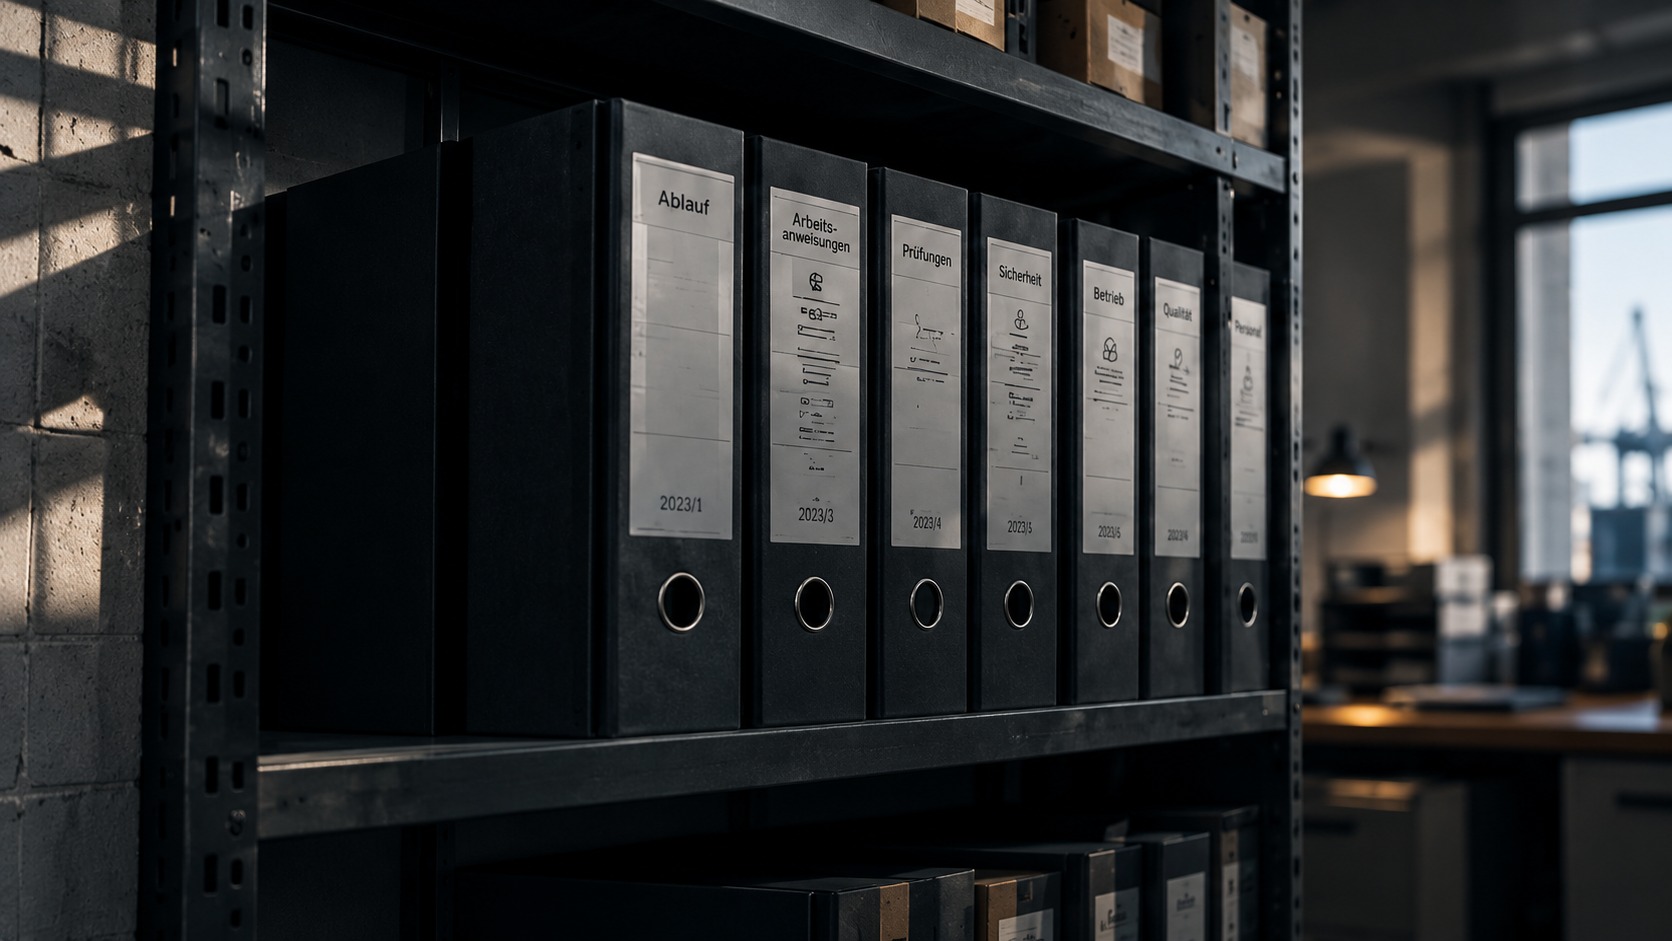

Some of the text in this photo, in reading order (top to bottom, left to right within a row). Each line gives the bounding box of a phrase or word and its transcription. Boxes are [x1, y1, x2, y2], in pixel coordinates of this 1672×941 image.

[658, 190, 710, 216] Ablauf
[792, 212, 838, 234] Arbeits-
[782, 229, 851, 254] anweisungen
[902, 243, 952, 268] Prüfungen
[999, 264, 1042, 287] Sicherheit
[1094, 286, 1125, 306] Betrieb
[1163, 302, 1193, 322] Qualität
[660, 495, 703, 513] 2023/1
[798, 507, 834, 524] 2023/3
[912, 515, 942, 530] 2023/4
